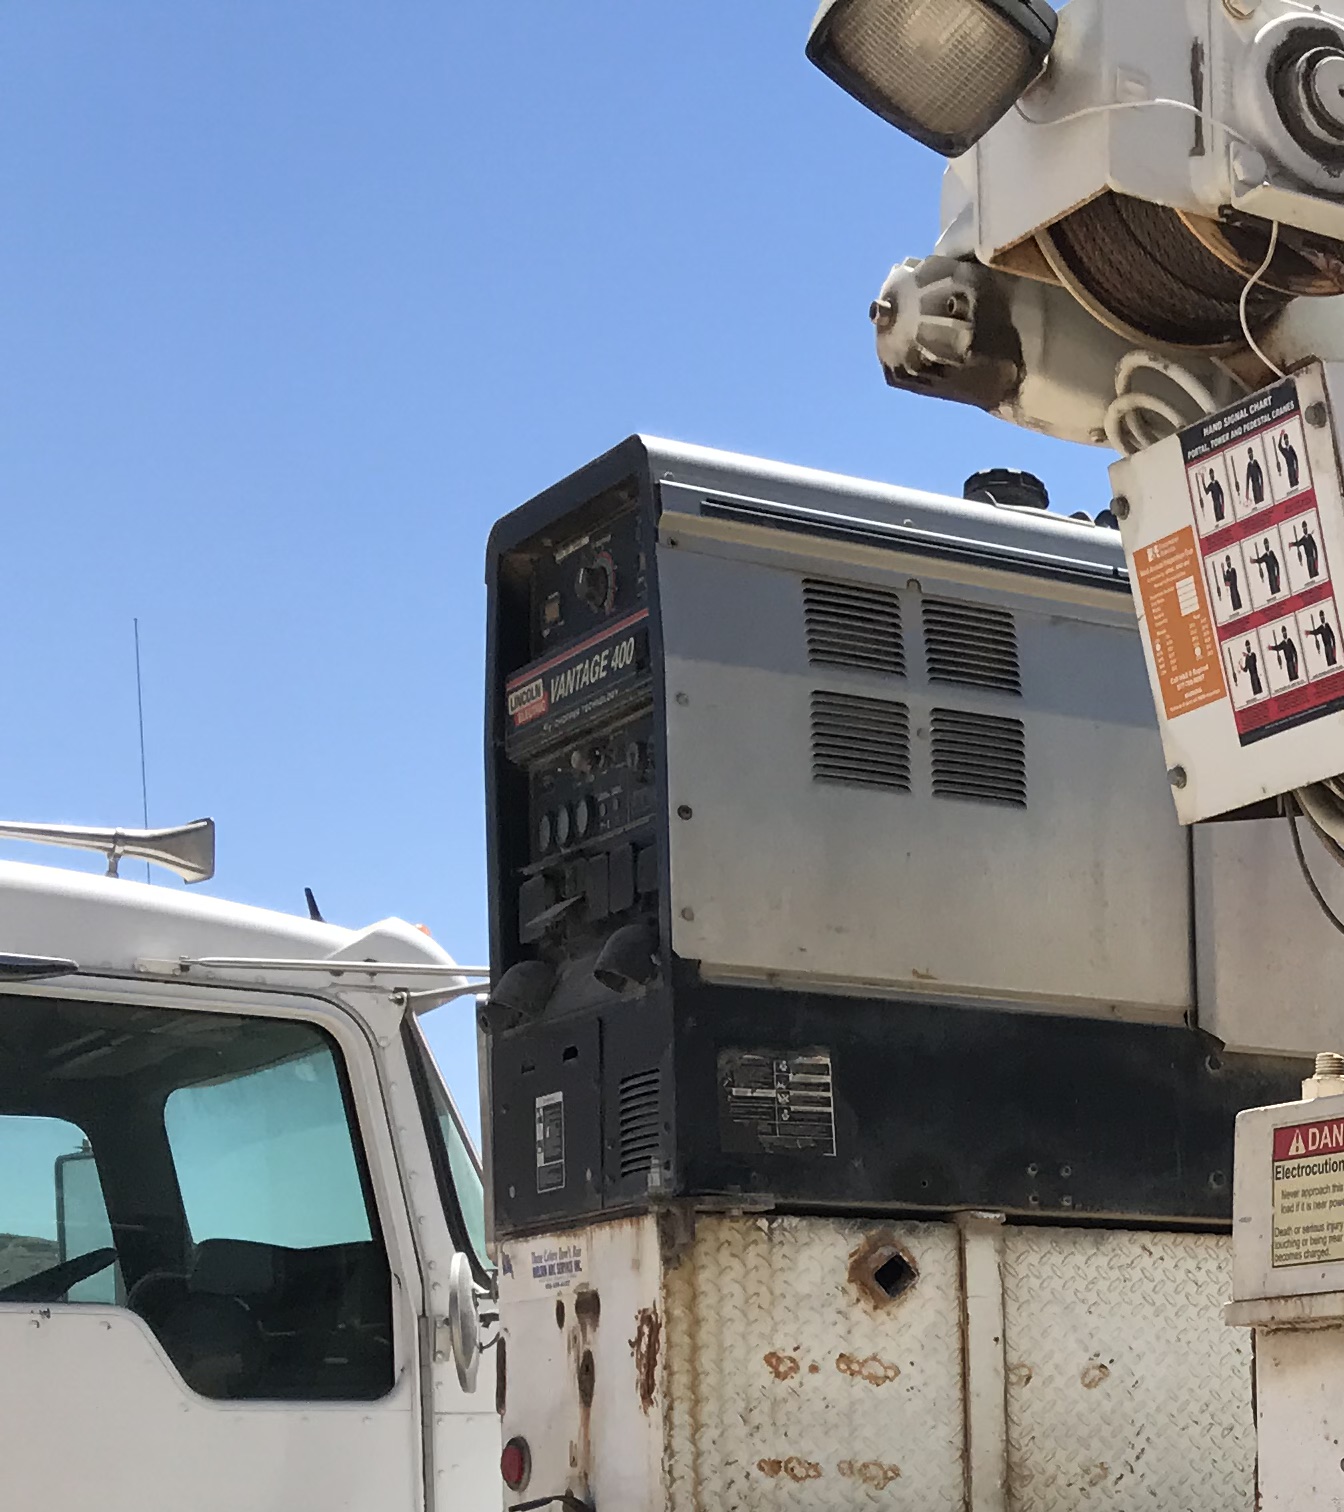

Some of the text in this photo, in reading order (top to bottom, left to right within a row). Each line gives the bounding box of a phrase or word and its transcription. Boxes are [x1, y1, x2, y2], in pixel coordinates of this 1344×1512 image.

[1203, 396, 1272, 437] HAND SIGNAL CHART
[1230, 426, 1242, 439] AND
[550, 637, 634, 703] VANTAGE 400
[1275, 1157, 1344, 1181] Electrocution
[1281, 1189, 1299, 1200] Never
[1301, 1184, 1330, 1198] approach
[1332, 1184, 1343, 1193] this
[1281, 1203, 1294, 1214] load
[1274, 1227, 1292, 1237] Death
[1274, 1251, 1302, 1262] becomes
